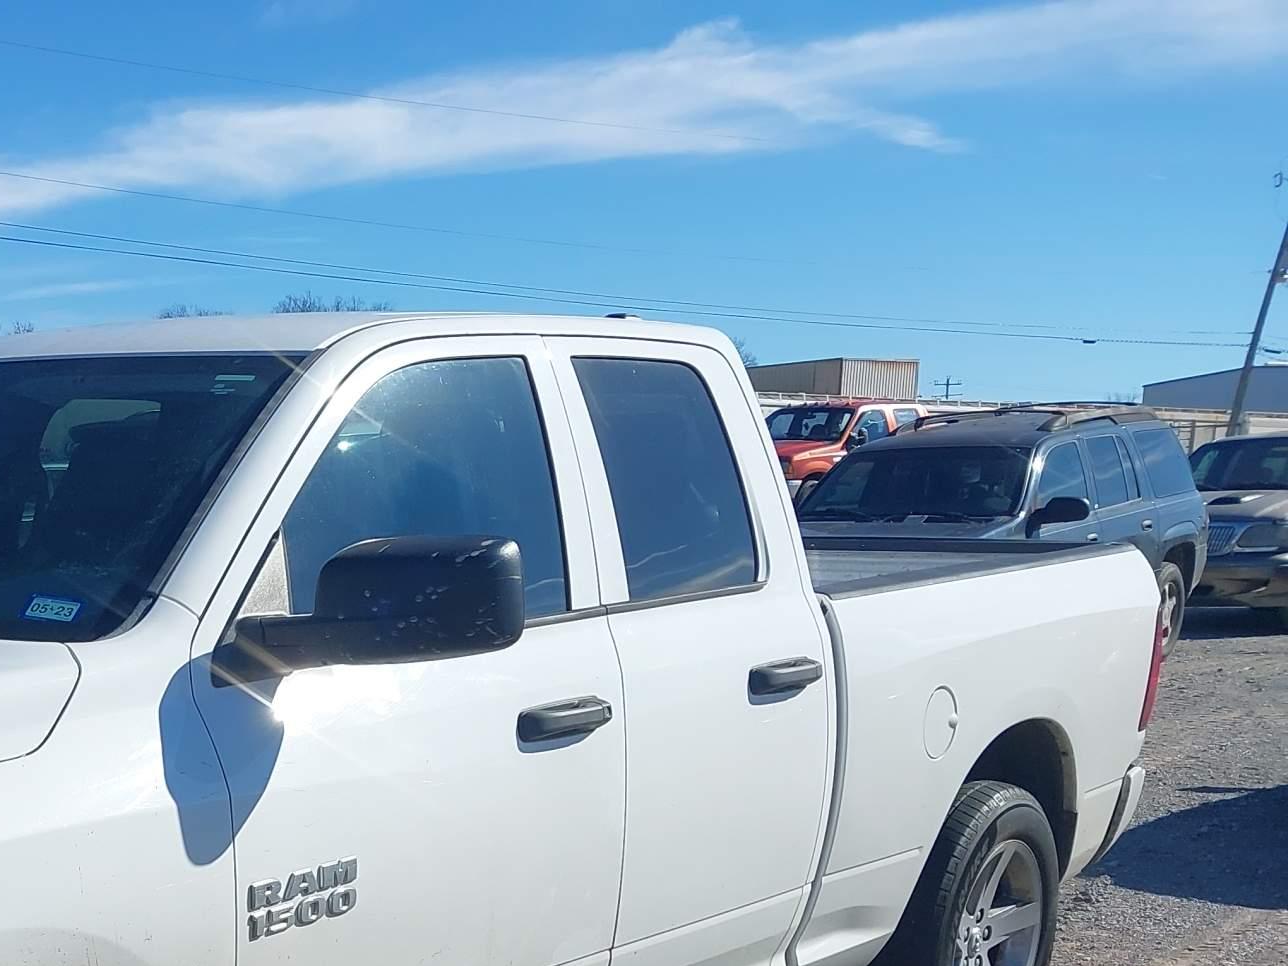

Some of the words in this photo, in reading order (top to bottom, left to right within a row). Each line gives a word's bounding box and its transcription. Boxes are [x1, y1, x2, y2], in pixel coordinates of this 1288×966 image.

[30, 602, 50, 614] 05
[54, 605, 74, 617] 23
[247, 855, 358, 912] RAM
[247, 886, 358, 942] 1500
